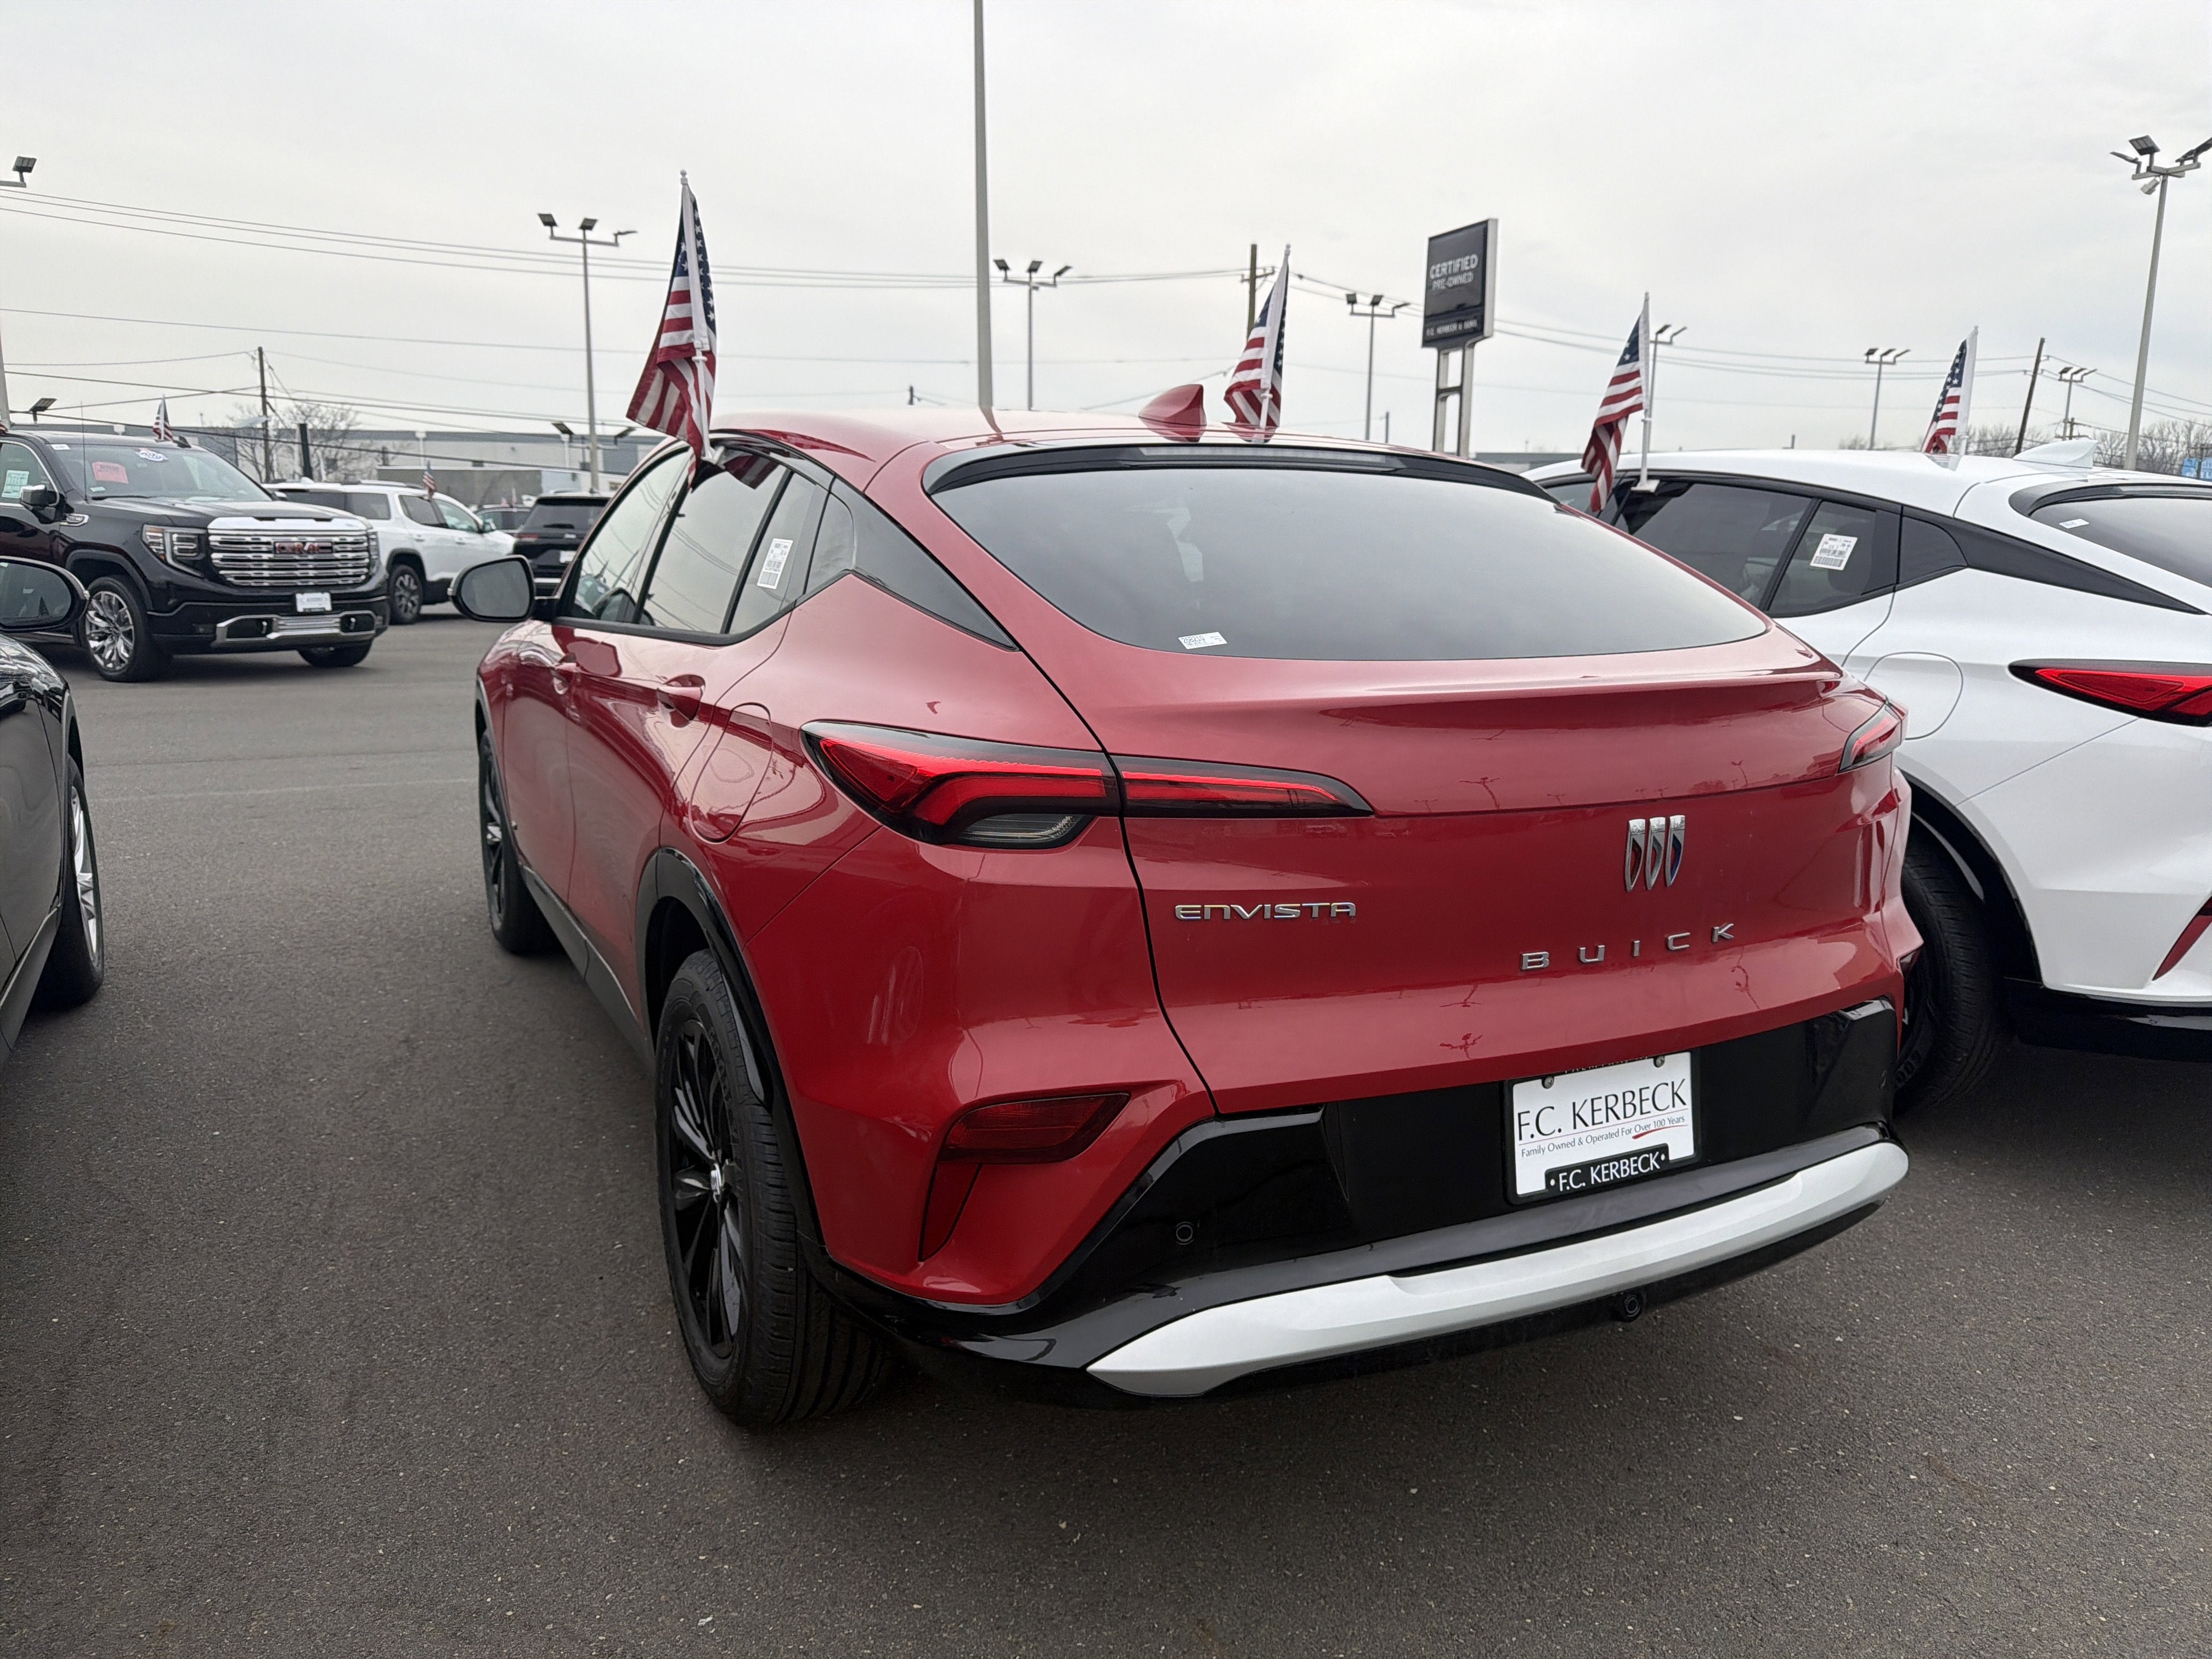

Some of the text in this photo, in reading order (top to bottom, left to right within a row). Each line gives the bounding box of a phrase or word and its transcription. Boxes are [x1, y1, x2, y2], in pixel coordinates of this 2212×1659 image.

[1430, 254, 1478, 280] CERTIFIED
[1175, 902, 1356, 919] ENVISTA
[1520, 923, 1734, 970] BUICK
[1518, 1079, 1687, 1141] F.C. KERBECK
[1521, 1144, 1545, 1158] Family
[1548, 1138, 1576, 1152] Owned
[1585, 1128, 1620, 1144] Operated
[1621, 1127, 1632, 1136] For
[1634, 1123, 1651, 1133] Over
[1653, 1118, 1666, 1128] 100
[1667, 1115, 1685, 1125] Years
[1559, 1151, 1661, 1192] F.C. KERBECK
